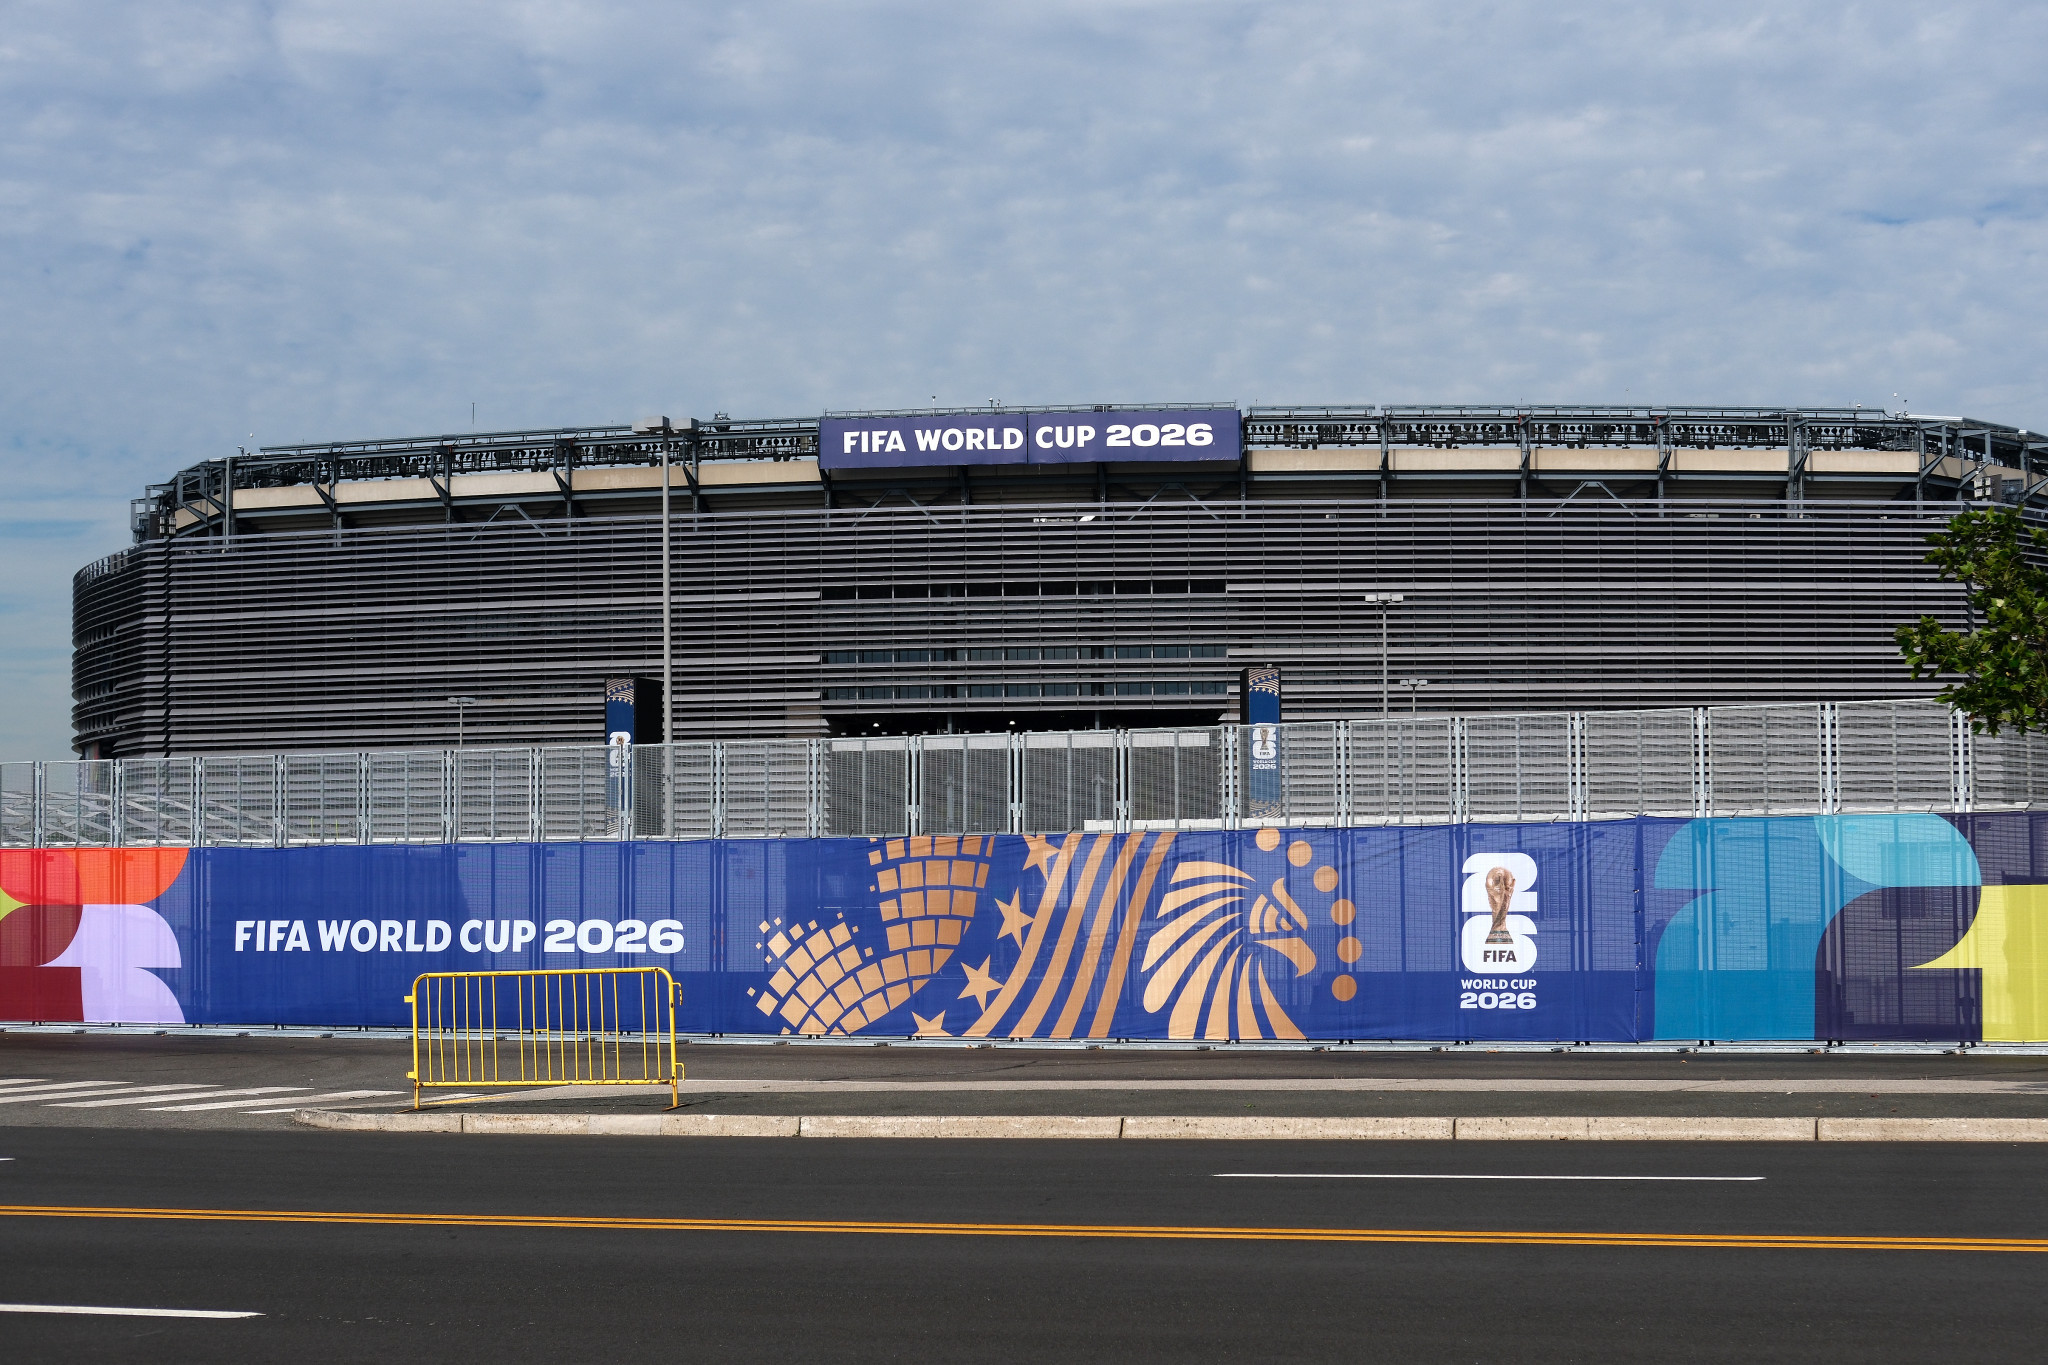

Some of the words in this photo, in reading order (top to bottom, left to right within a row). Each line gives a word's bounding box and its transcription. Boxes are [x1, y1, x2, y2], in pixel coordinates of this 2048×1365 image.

[843, 431, 906, 453] FIFA
[914, 428, 1024, 451] WORLD
[1035, 425, 1096, 449] CUP
[1106, 423, 1214, 447] 2026
[234, 920, 310, 952] FIFA
[317, 920, 452, 952] WORLD
[459, 919, 536, 952] CUP
[544, 919, 685, 954] 2026
[1483, 950, 1517, 962] FIFA
[1461, 979, 1508, 990] WORLD
[1510, 979, 1537, 990] CUP
[1460, 992, 1537, 1010] 2026
